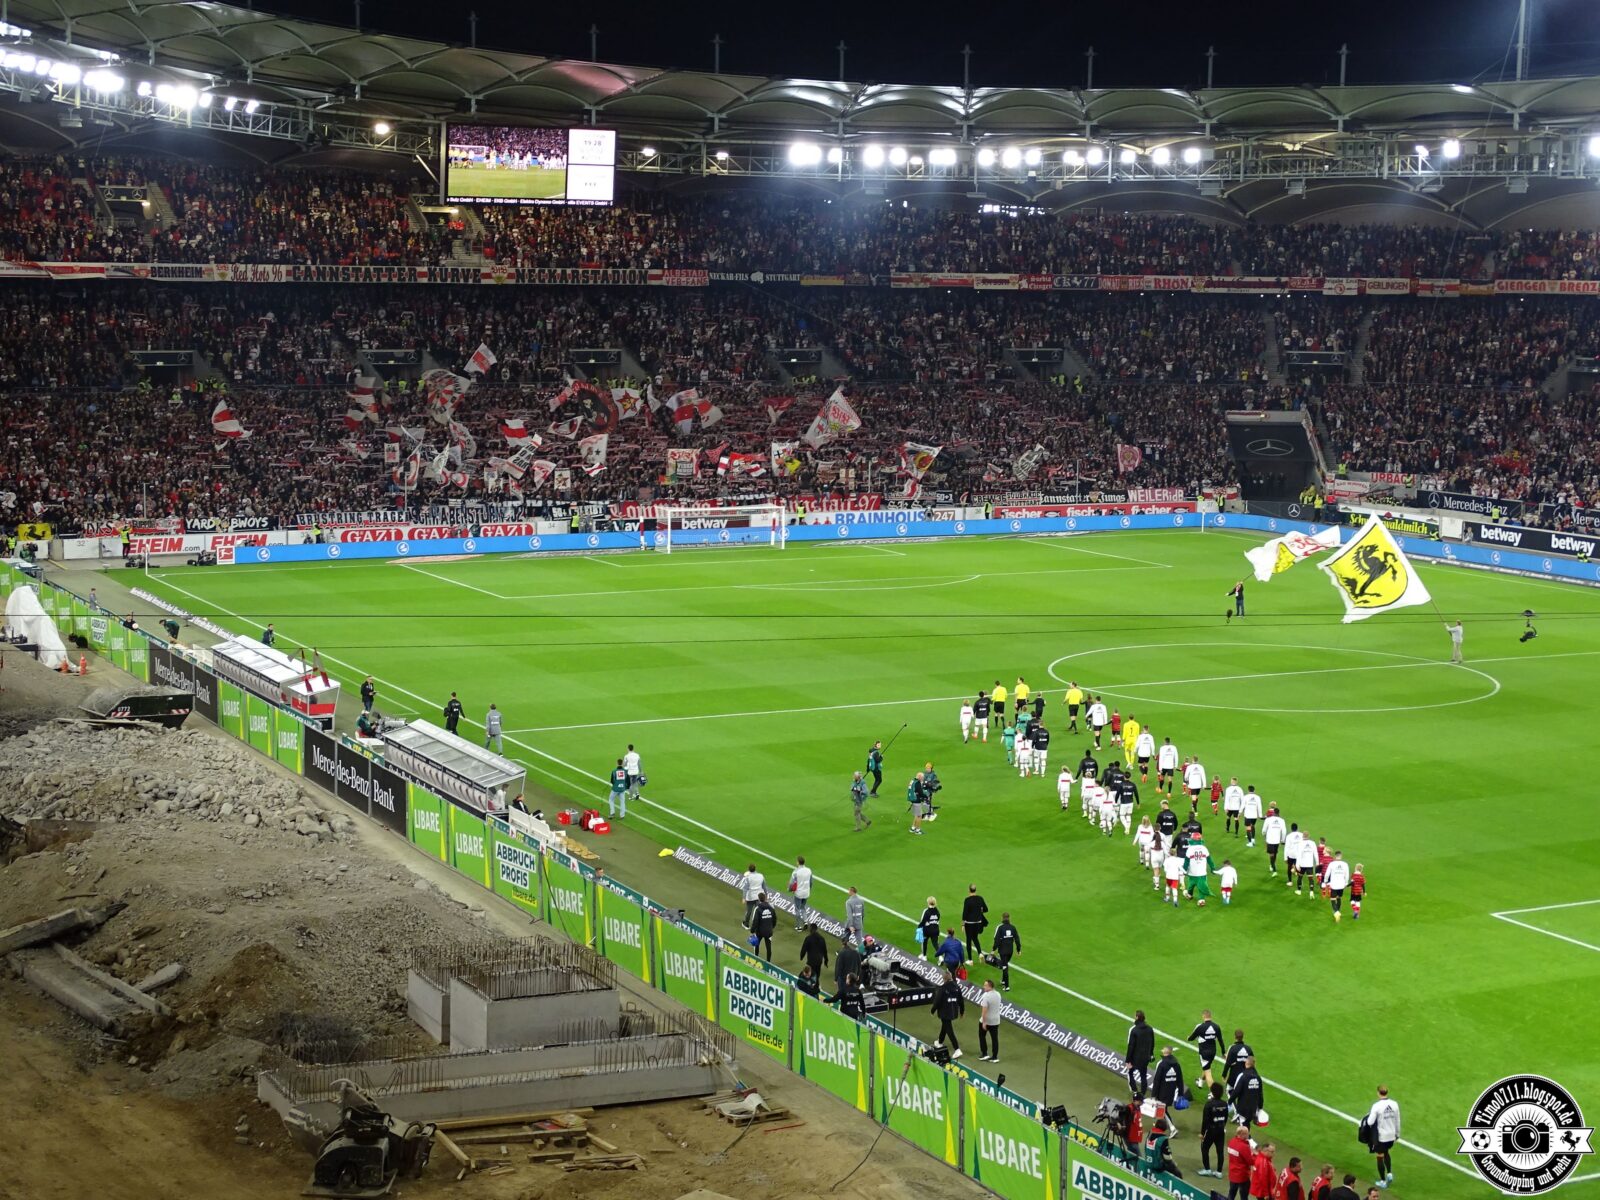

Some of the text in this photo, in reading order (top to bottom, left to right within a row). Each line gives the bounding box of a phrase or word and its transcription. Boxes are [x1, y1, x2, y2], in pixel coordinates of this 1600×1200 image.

[292, 266, 481, 284] CANNSTATTER KURVE
[515, 268, 649, 285] NECKARSTADION
[766, 273, 801, 282] STUTTGART
[1084, 276, 1097, 288] 77
[1497, 281, 1596, 292] GIENGEN BRENZ
[859, 495, 878, 511] 97
[1443, 496, 1508, 516] Mercedes-Bnz
[681, 518, 728, 530] betway
[835, 511, 926, 525] BRAINHOUS
[935, 511, 954, 521] 247
[347, 529, 399, 542] GAZI
[1481, 525, 1596, 556] betway betway
[222, 699, 240, 717] LIBARE
[249, 715, 268, 733] LIBARE
[278, 731, 298, 750] LIBARE
[312, 744, 370, 797] Mercedes-Benz
[373, 779, 395, 813] Bank
[414, 809, 440, 833] LIBARE
[456, 832, 484, 858] LIBARE
[497, 844, 535, 871] ABBRUCH
[501, 864, 528, 888] PROFIS
[549, 886, 584, 916] LIBARE
[604, 916, 641, 948] LIBARE
[672, 846, 720, 877] Mercedes-Benz
[718, 868, 741, 888] Bank
[1042, 1022, 1075, 1048] Bank
[664, 950, 705, 984] LIBARE
[725, 970, 784, 1009] ABBRUCH
[731, 995, 772, 1027] PROFIS
[748, 1024, 783, 1049] libare.de
[805, 1029, 856, 1070] LIBARE
[887, 1075, 943, 1120] LIBARE
[979, 1127, 1043, 1180] LIBARE
[1075, 1165, 1157, 1200] ABBRU
